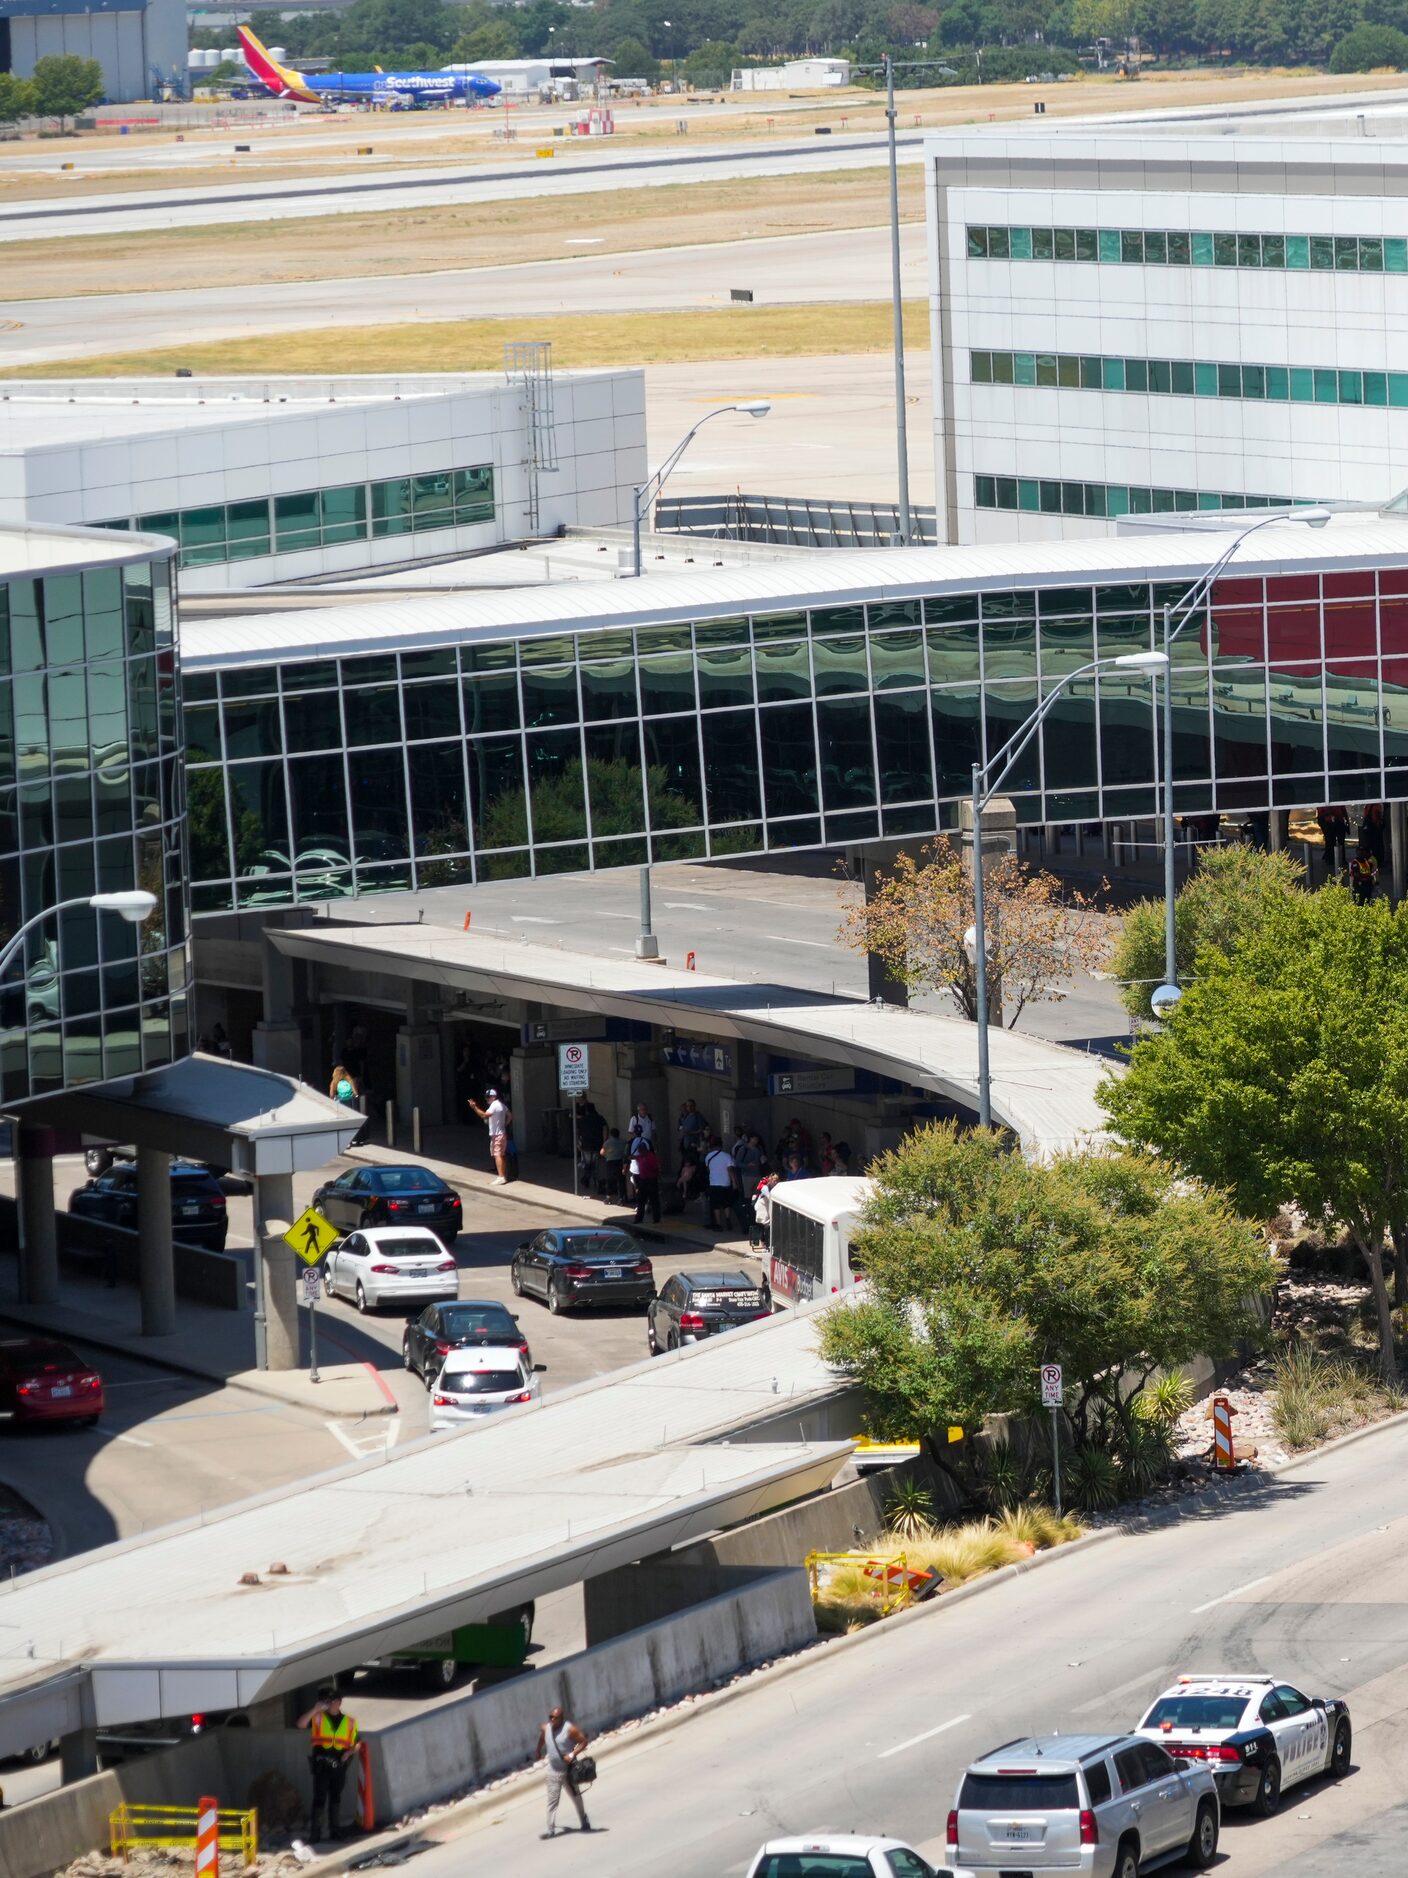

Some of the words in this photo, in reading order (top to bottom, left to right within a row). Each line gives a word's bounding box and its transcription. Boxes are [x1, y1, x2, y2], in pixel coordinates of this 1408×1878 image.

[386, 76, 455, 88] Southwest
[773, 1260, 789, 1290] AVIS
[1168, 1687, 1254, 1697] 4248
[1283, 1732, 1319, 1767] POLICE
